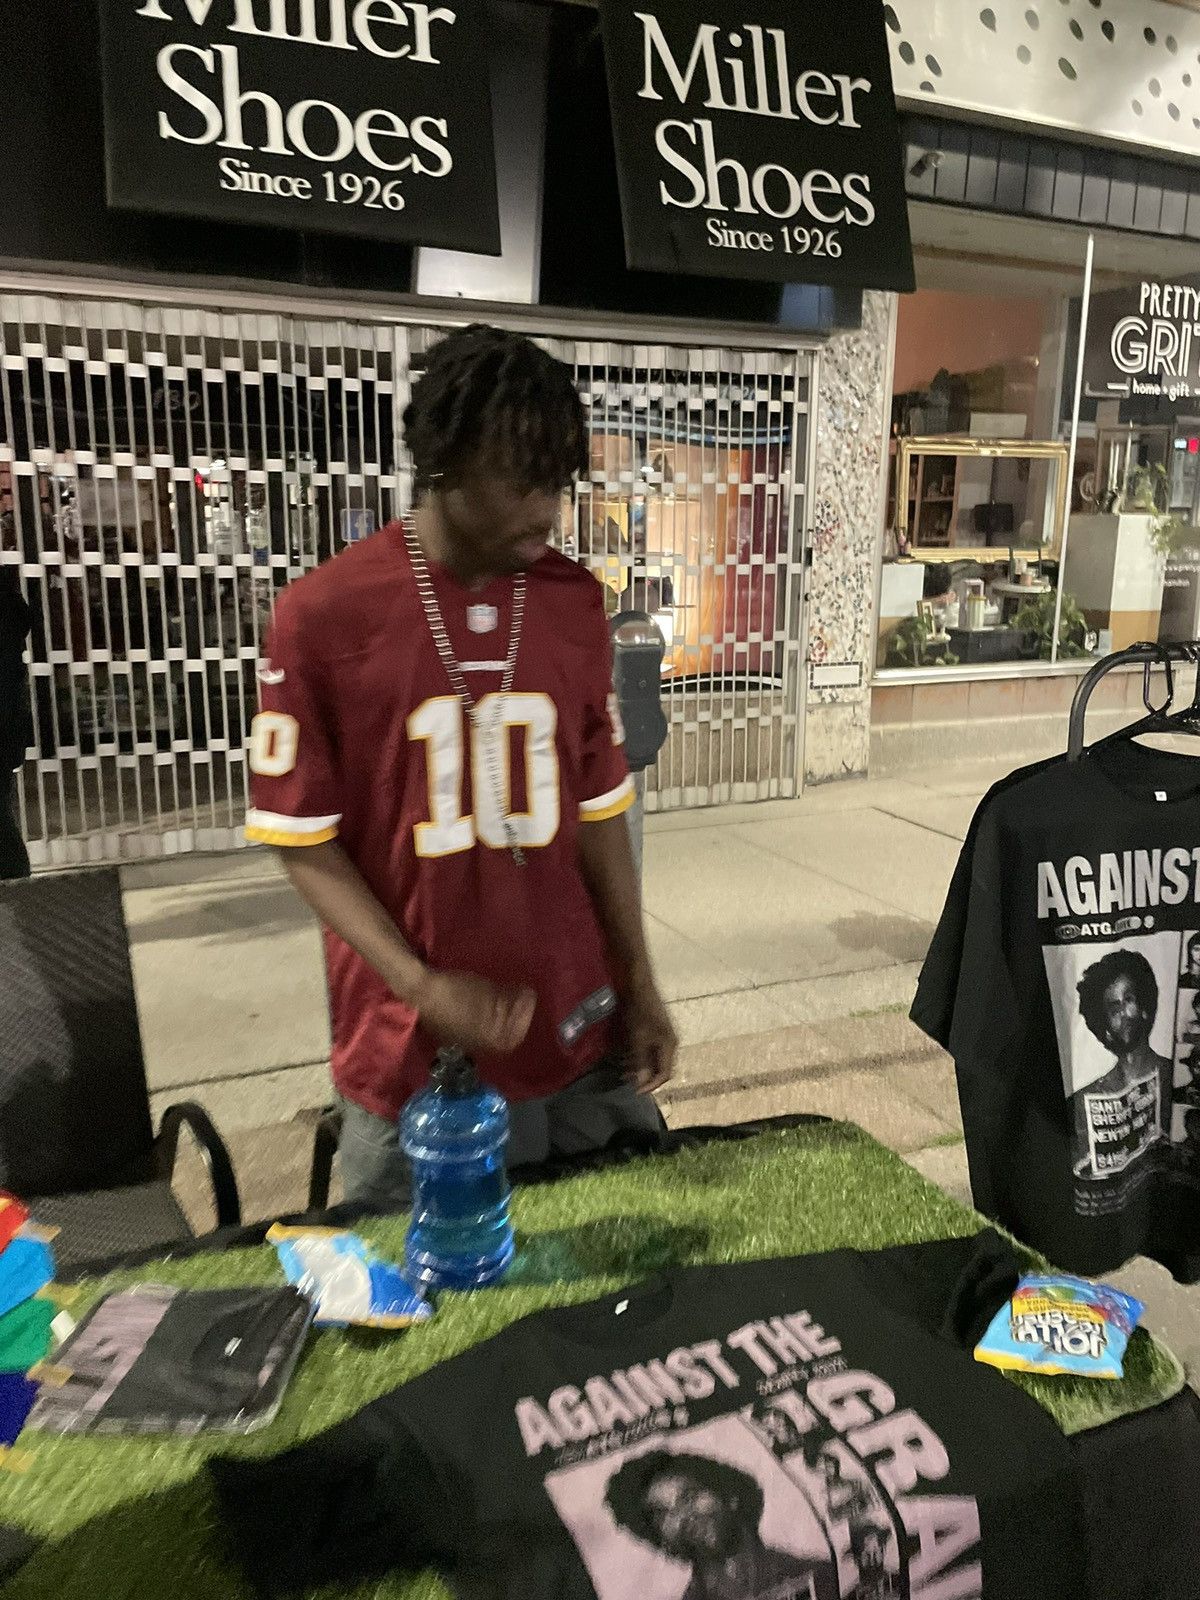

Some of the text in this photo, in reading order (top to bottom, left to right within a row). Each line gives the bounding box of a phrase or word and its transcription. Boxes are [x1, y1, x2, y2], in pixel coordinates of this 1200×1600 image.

[633, 11, 872, 129] Miller
[156, 42, 454, 178] Shoes
[218, 157, 406, 211] Since 1926
[654, 118, 876, 227] Shoes
[706, 217, 843, 259] Since 1926
[1139, 281, 1200, 321] PRETTY
[1110, 315, 1200, 378] GRI
[1132, 377, 1161, 395] home
[1168, 381, 1191, 402] gift
[249, 710, 300, 777] 0
[406, 691, 560, 858] 10
[1017, 1317, 1105, 1359] JOLLY
[514, 1338, 740, 1457] AGAINST
[726, 1309, 843, 1379] THE
